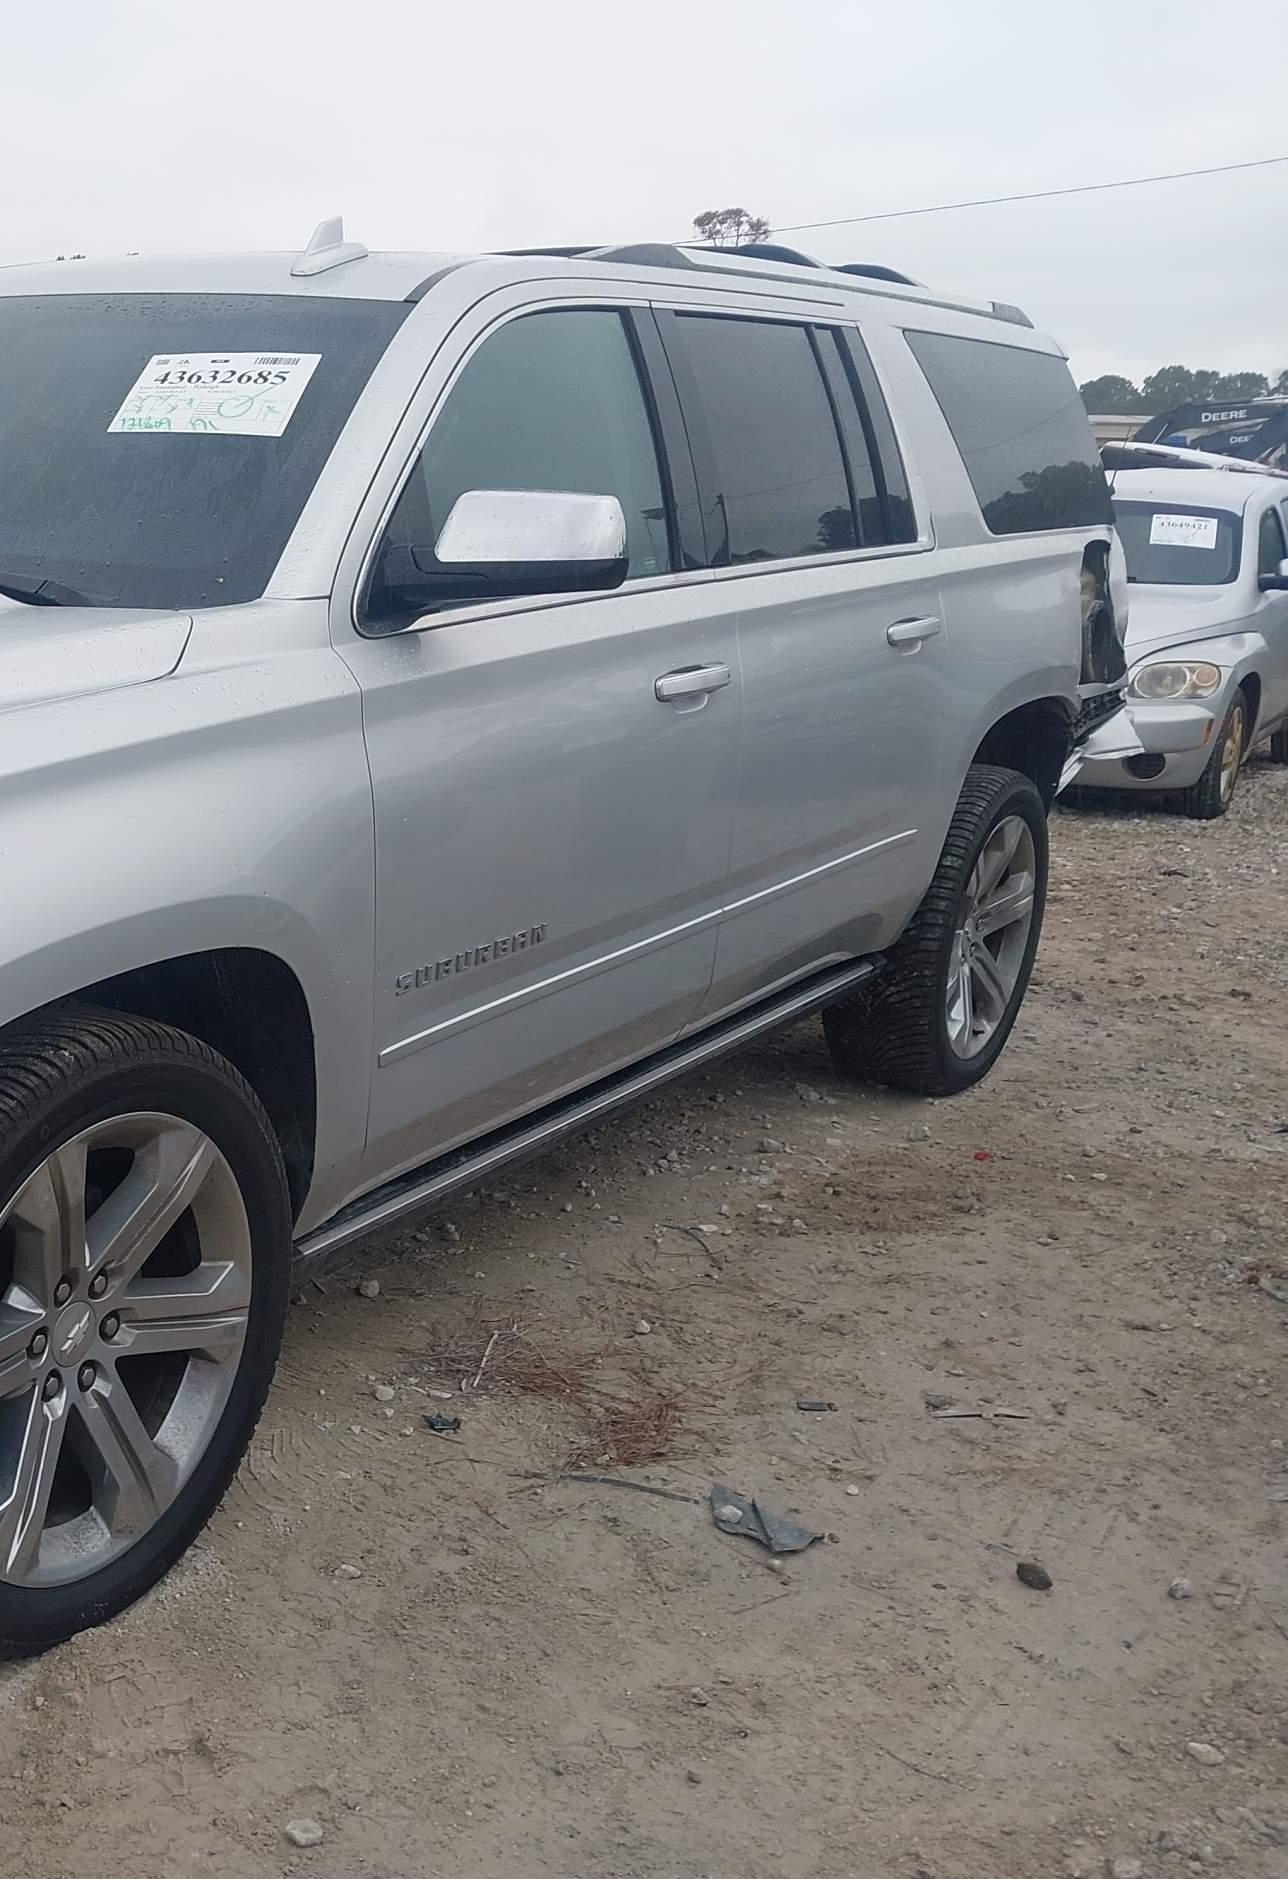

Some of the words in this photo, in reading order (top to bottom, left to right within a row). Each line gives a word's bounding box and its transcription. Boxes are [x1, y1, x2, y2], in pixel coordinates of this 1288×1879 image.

[153, 369, 291, 386] 43632685
[1201, 409, 1248, 423] DEERE
[394, 922, 549, 997] SUBURBAN
